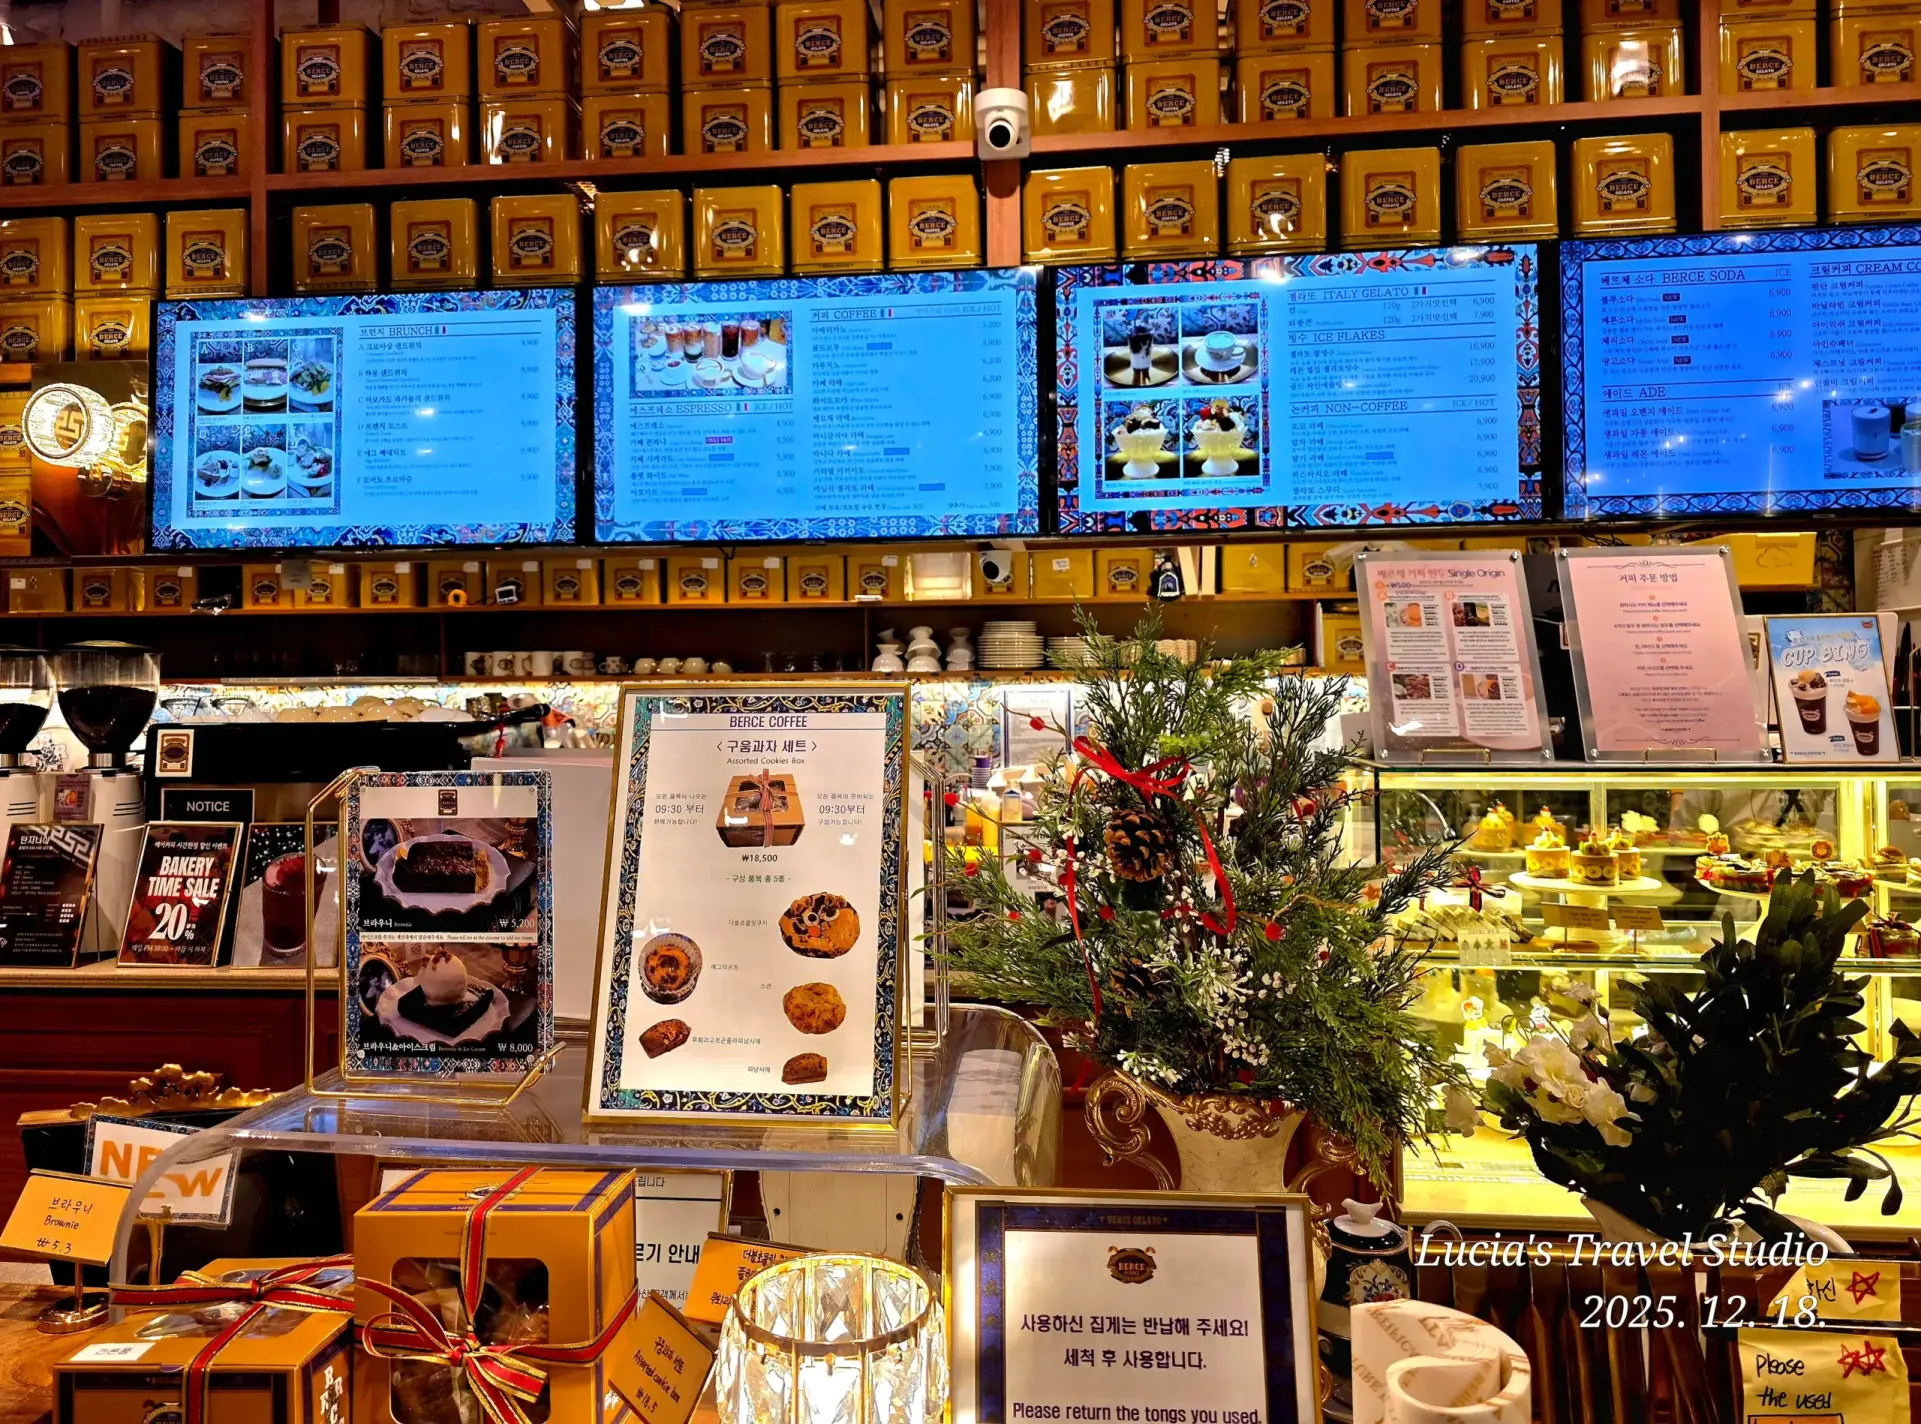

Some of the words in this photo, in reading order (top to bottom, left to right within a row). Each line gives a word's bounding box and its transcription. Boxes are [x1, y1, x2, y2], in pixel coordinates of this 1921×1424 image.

[1811, 264, 1851, 274] 크림커피
[1856, 262, 1903, 273] CREAM
[1601, 274, 1630, 286] 베르체
[1634, 274, 1655, 284] 소다
[1662, 271, 1705, 284] BERCE
[1710, 269, 1746, 281] SODA
[1776, 268, 1791, 276] ICE
[1323, 288, 1357, 299] ITALY
[1362, 287, 1409, 298] GELATO
[1383, 302, 1401, 311] 120g
[1473, 297, 1494, 306] 6,900
[812, 310, 829, 320] 커피
[834, 309, 877, 319] COFFEE
[983, 303, 1001, 312] HOT
[1383, 316, 1401, 324] 120g
[360, 328, 384, 336] 브런치
[389, 326, 433, 336] BRUNCH
[1288, 333, 1307, 343] 빙수
[1314, 332, 1334, 342] ICE
[1337, 330, 1385, 341] FLAKES
[1468, 342, 1494, 351] 16,900
[1469, 358, 1495, 366] 17,900
[1602, 356, 1635, 366] 망고소다
[1468, 374, 1495, 383] 20,900
[1603, 388, 1632, 399] 에이드
[1639, 387, 1666, 398] ADE
[630, 405, 673, 414] 에스프레소
[676, 403, 732, 414] ESPRESSO
[755, 402, 767, 411] ICE
[775, 402, 793, 410] HOT
[1291, 403, 1319, 414] 논커피
[1325, 401, 1408, 413] NON-COFFEE
[1603, 407, 1627, 417] 생과일
[1630, 407, 1656, 416] 오렌지
[1658, 406, 1683, 415] 에이드
[1772, 403, 1794, 411] 6,900
[1476, 417, 1497, 425] 6,900
[1604, 428, 1627, 438] 생과일
[1630, 428, 1647, 438] 자몽
[1650, 428, 1675, 436] 에이드
[1772, 424, 1794, 432] 6,900
[1604, 450, 1628, 459] 생과일
[1632, 450, 1648, 459] 레몬
[1651, 449, 1676, 458] 에이드
[1772, 445, 1794, 454] 6,900
[1448, 569, 1475, 578] Single
[1477, 569, 1505, 579] Origin
[1620, 574, 1636, 583] 커피
[1640, 574, 1657, 582] 주문
[1660, 573, 1678, 582] 방법
[1784, 648, 1816, 667] CUP
[1822, 644, 1869, 663] BING
[730, 716, 765, 728] BERCE
[769, 716, 808, 728] COFFEE
[726, 740, 777, 753] 구움과자
[782, 740, 807, 753] 세트
[726, 757, 758, 765] Assorted
[186, 801, 229, 812] NOTICE
[656, 805, 682, 813] 09:30
[686, 804, 704, 814] 부터
[819, 805, 865, 814] 09:30부터
[20, 836, 50, 845] 탄자니아
[742, 854, 778, 863] ₩18,500
[160, 856, 215, 876] BAKERY
[147, 877, 183, 897] TIME
[184, 878, 220, 898] SALE
[148, 903, 188, 940] 20
[185, 930, 194, 940] %
[363, 918, 392, 927] 브라우니
[499, 919, 508, 927] ₩
[511, 919, 535, 928] 5,200
[363, 1042, 436, 1052] 브라우니&아이스크림
[510, 1043, 533, 1052] 8,000
[48, 1197, 93, 1214] 브라우니
[44, 1215, 79, 1229] Brownie
[1133, 1216, 1161, 1225] GELATO
[668, 1244, 700, 1264] 안내
[1020, 1314, 1085, 1334] 사용하신
[1089, 1315, 1137, 1335] 집게는
[1143, 1317, 1190, 1336] 반납해
[1196, 1318, 1248, 1338] 주세요!
[1064, 1349, 1095, 1368] 세척
[1101, 1349, 1117, 1368] 후
[1122, 1350, 1207, 1370] 사용합니다.
[1756, 1353, 1804, 1377] Please
[1757, 1387, 1787, 1407] the
[1796, 1392, 1832, 1409] used
[1013, 1402, 1061, 1420] Please
[1066, 1404, 1110, 1421] return
[1116, 1404, 1140, 1421] the
[1145, 1406, 1186, 1424] tongs
[1191, 1410, 1219, 1424] you
[1222, 1408, 1262, 1424] used.
